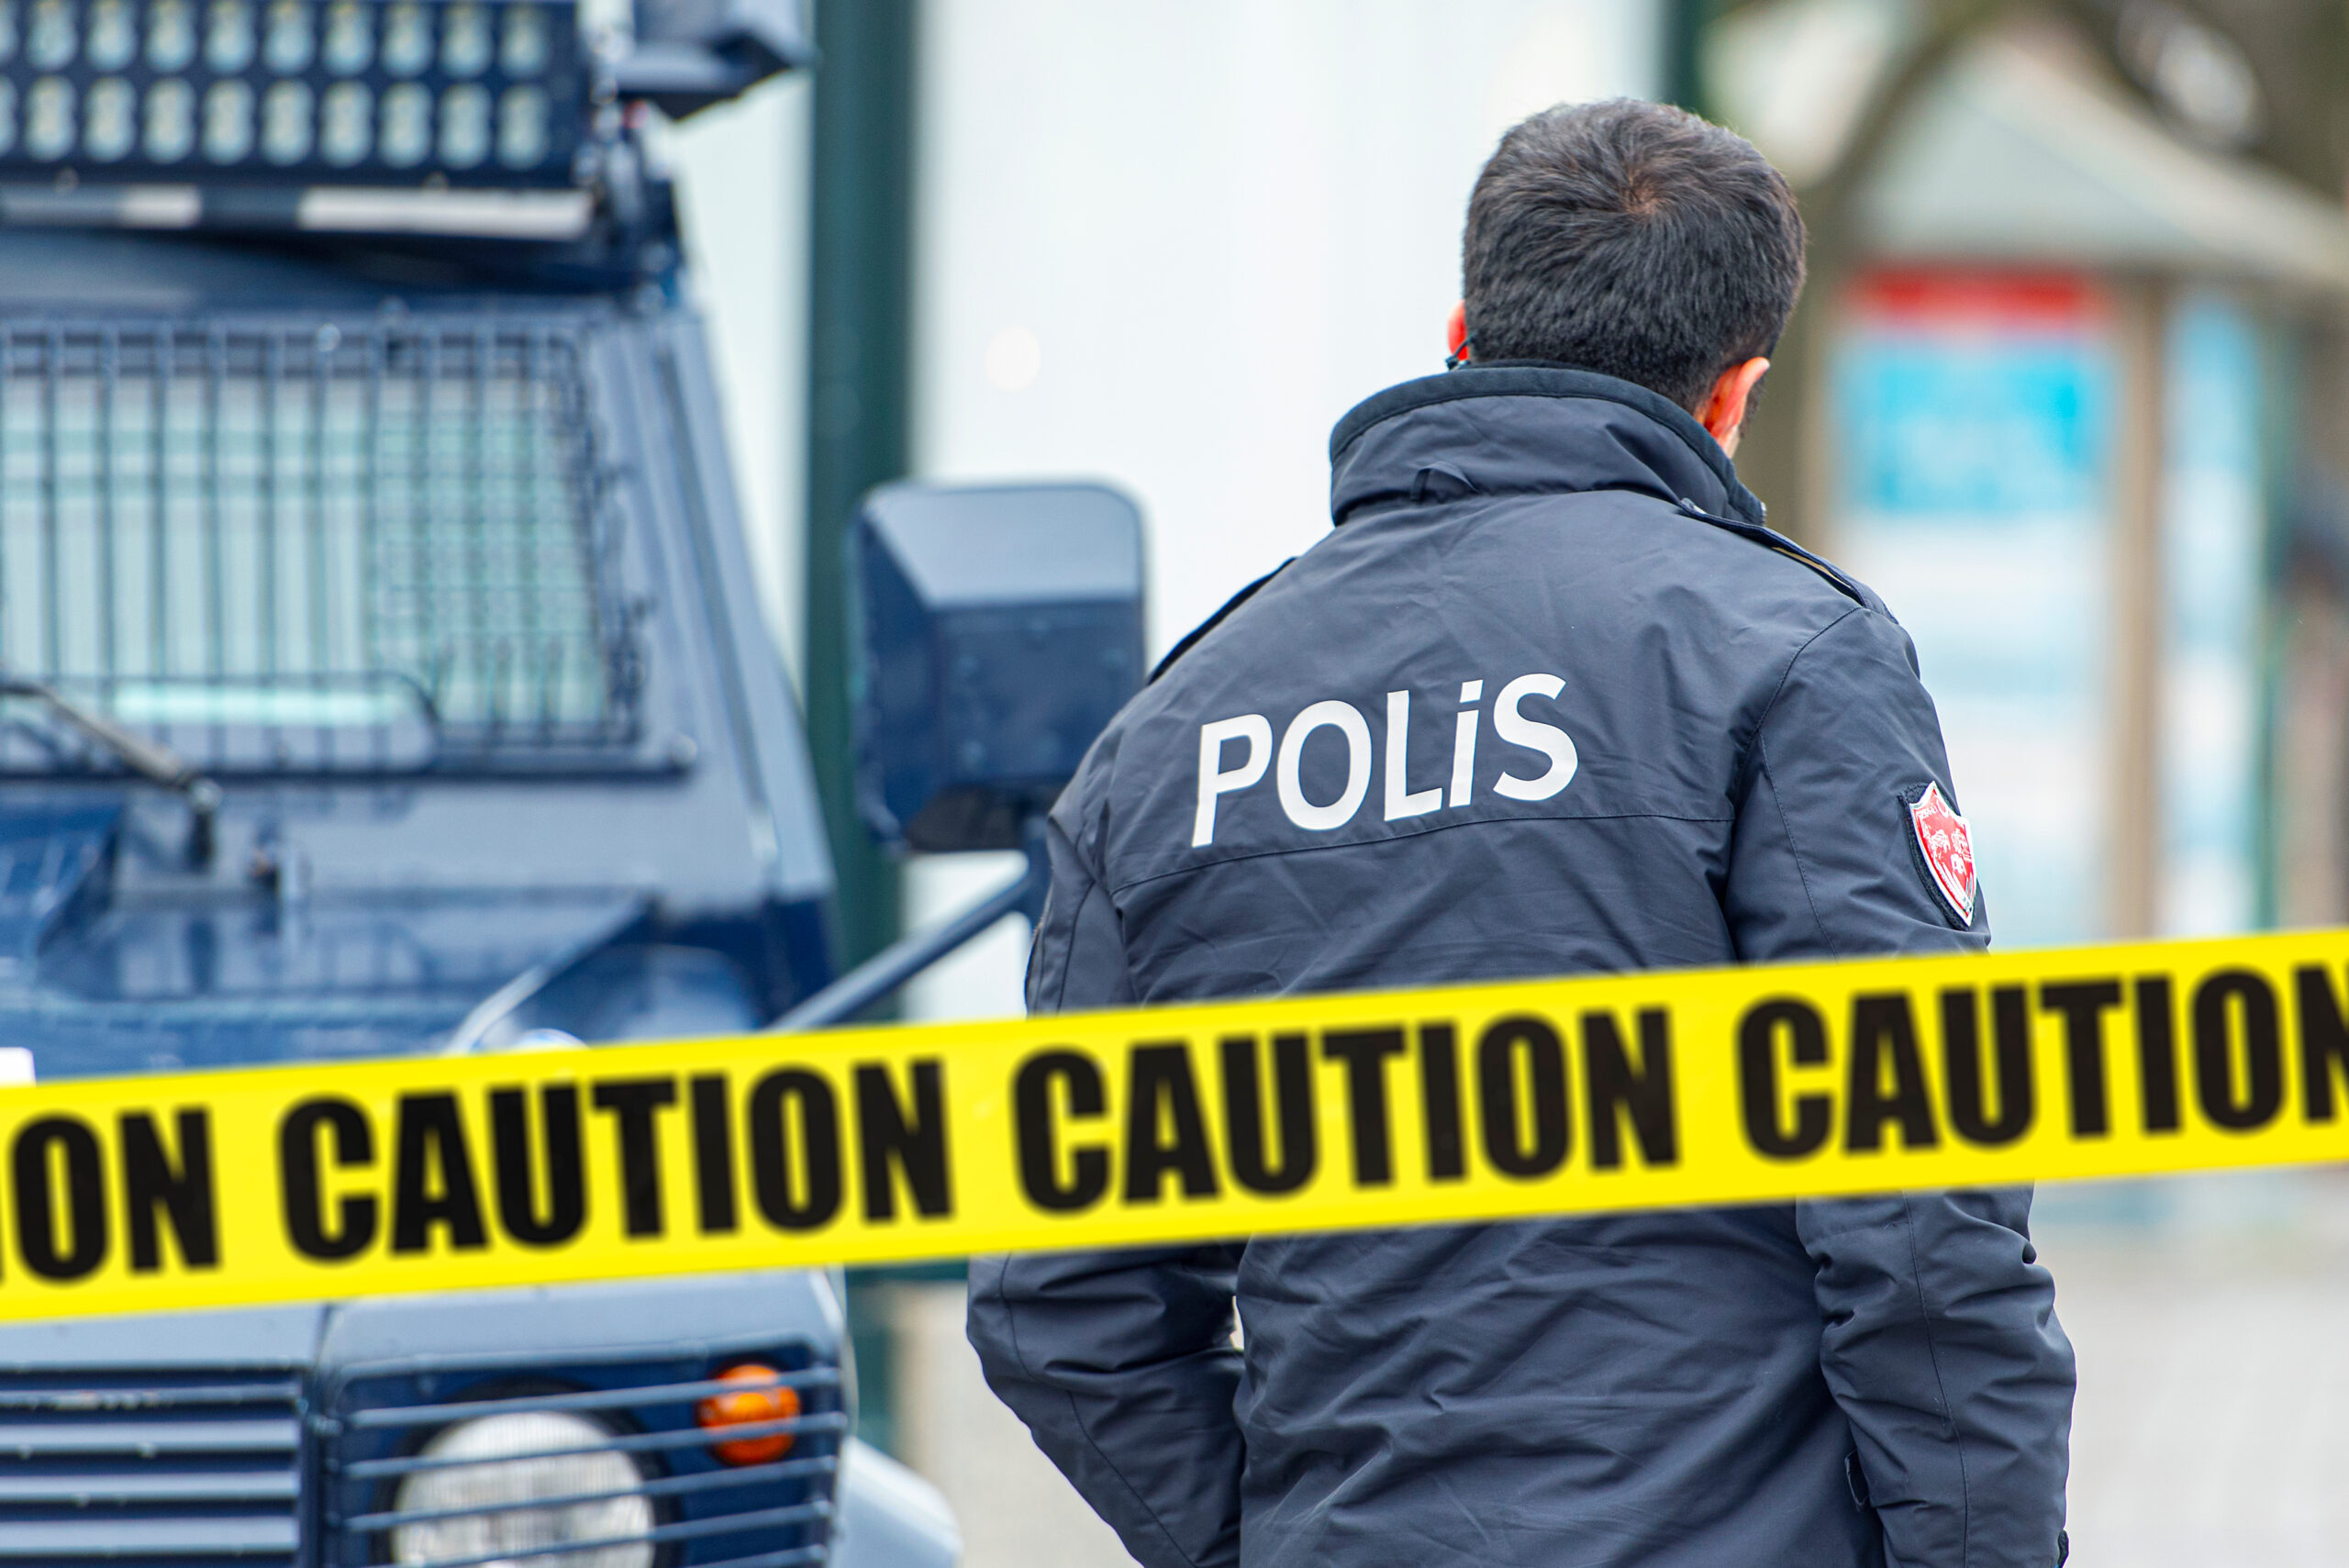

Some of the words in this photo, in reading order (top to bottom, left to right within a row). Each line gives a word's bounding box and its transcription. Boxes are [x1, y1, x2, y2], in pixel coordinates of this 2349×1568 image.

[0, 1105, 223, 1286] ON
[276, 1056, 954, 1265] CAUTION
[1010, 1005, 1680, 1217] CAUTION
